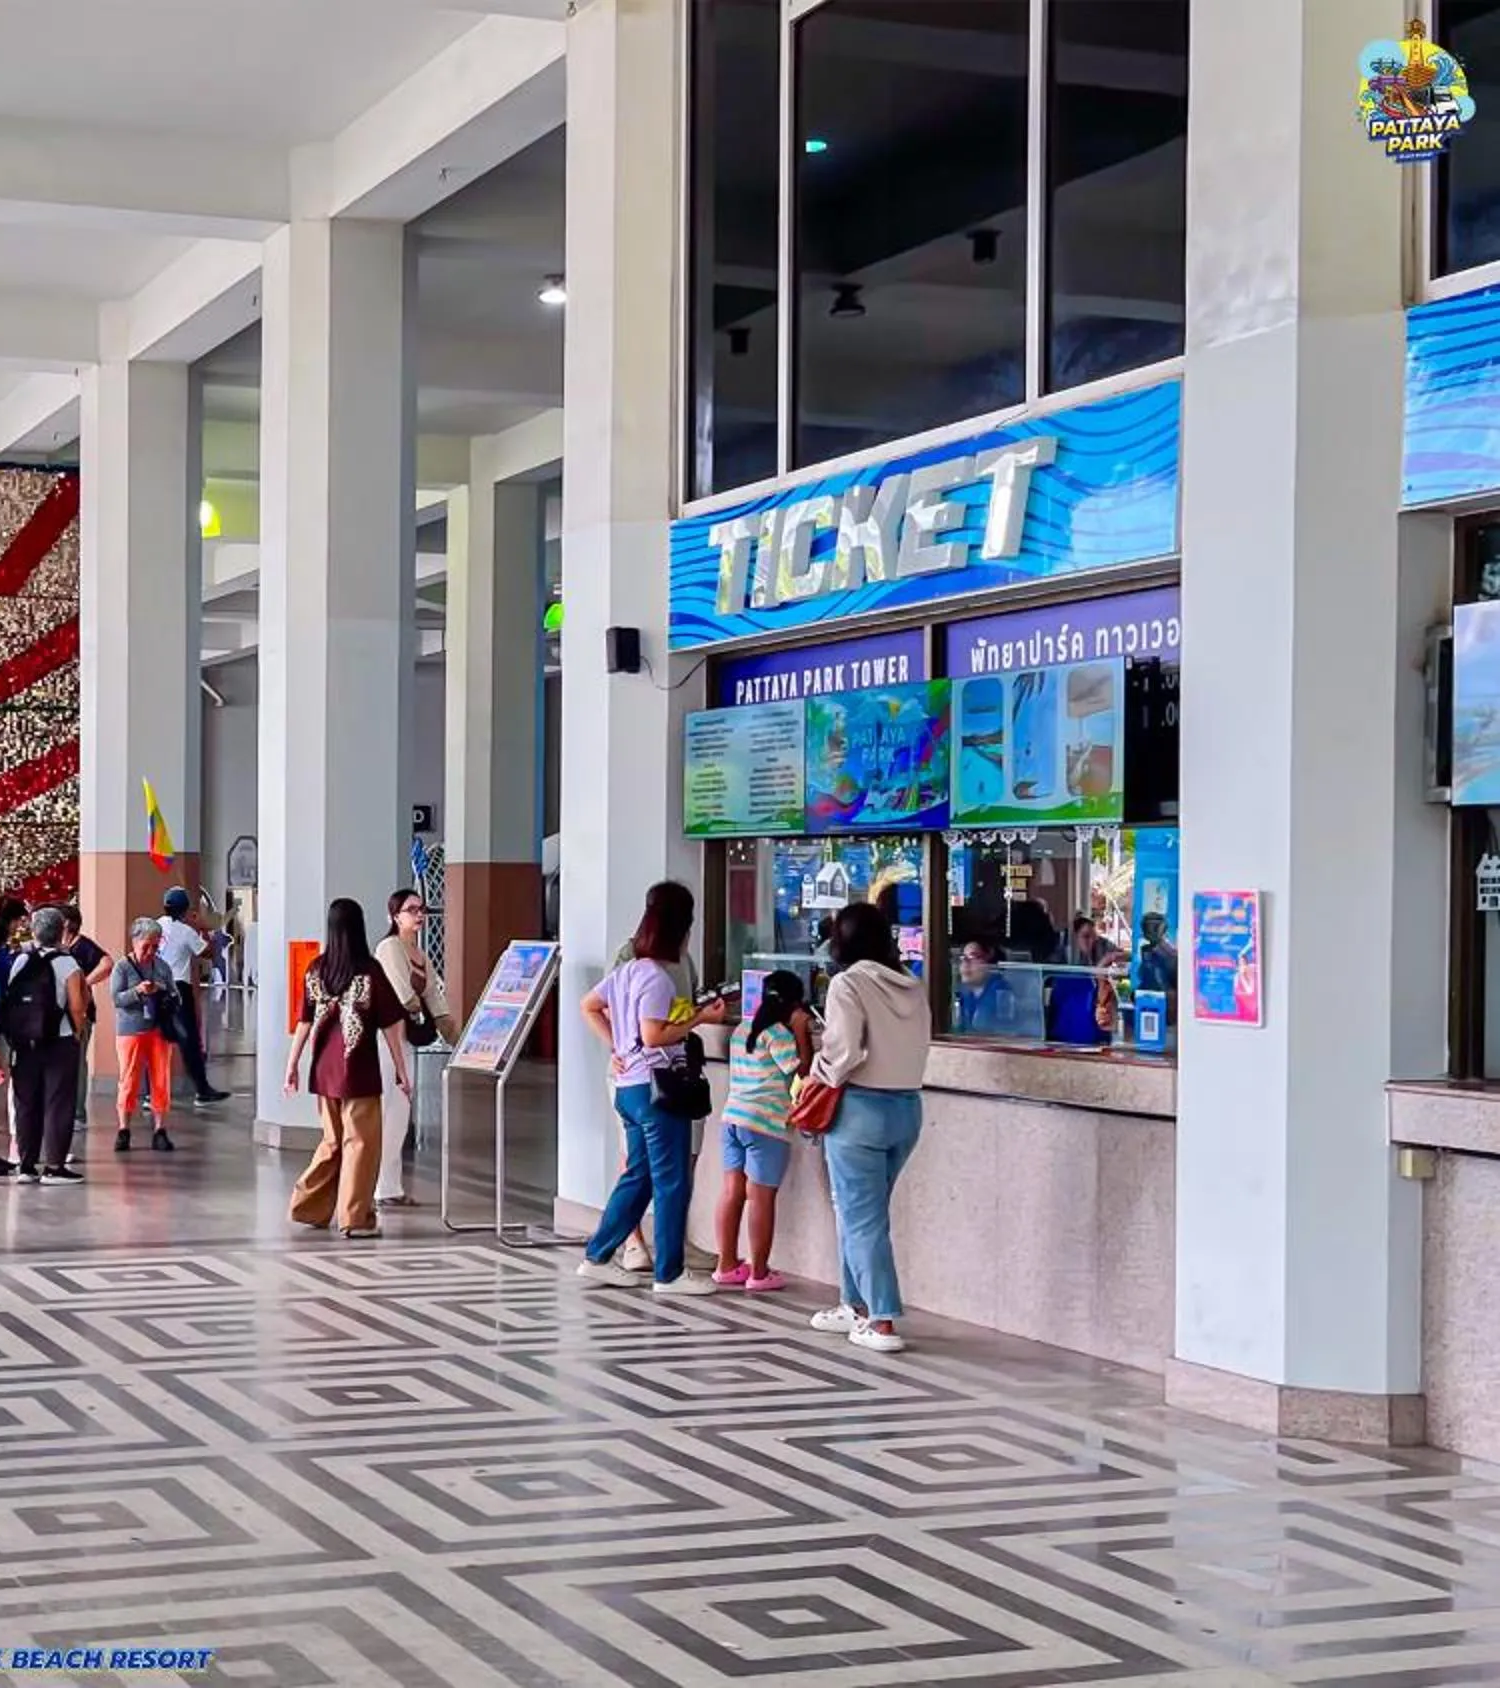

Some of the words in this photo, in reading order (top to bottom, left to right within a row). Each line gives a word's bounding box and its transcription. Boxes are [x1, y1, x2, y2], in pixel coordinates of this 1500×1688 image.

[708, 434, 1058, 617] TICKET
[970, 623, 1084, 674] พัทยาปาร์ค
[735, 671, 798, 706] PATTAYA
[802, 663, 846, 697] PARK
[851, 654, 909, 690] TOWER
